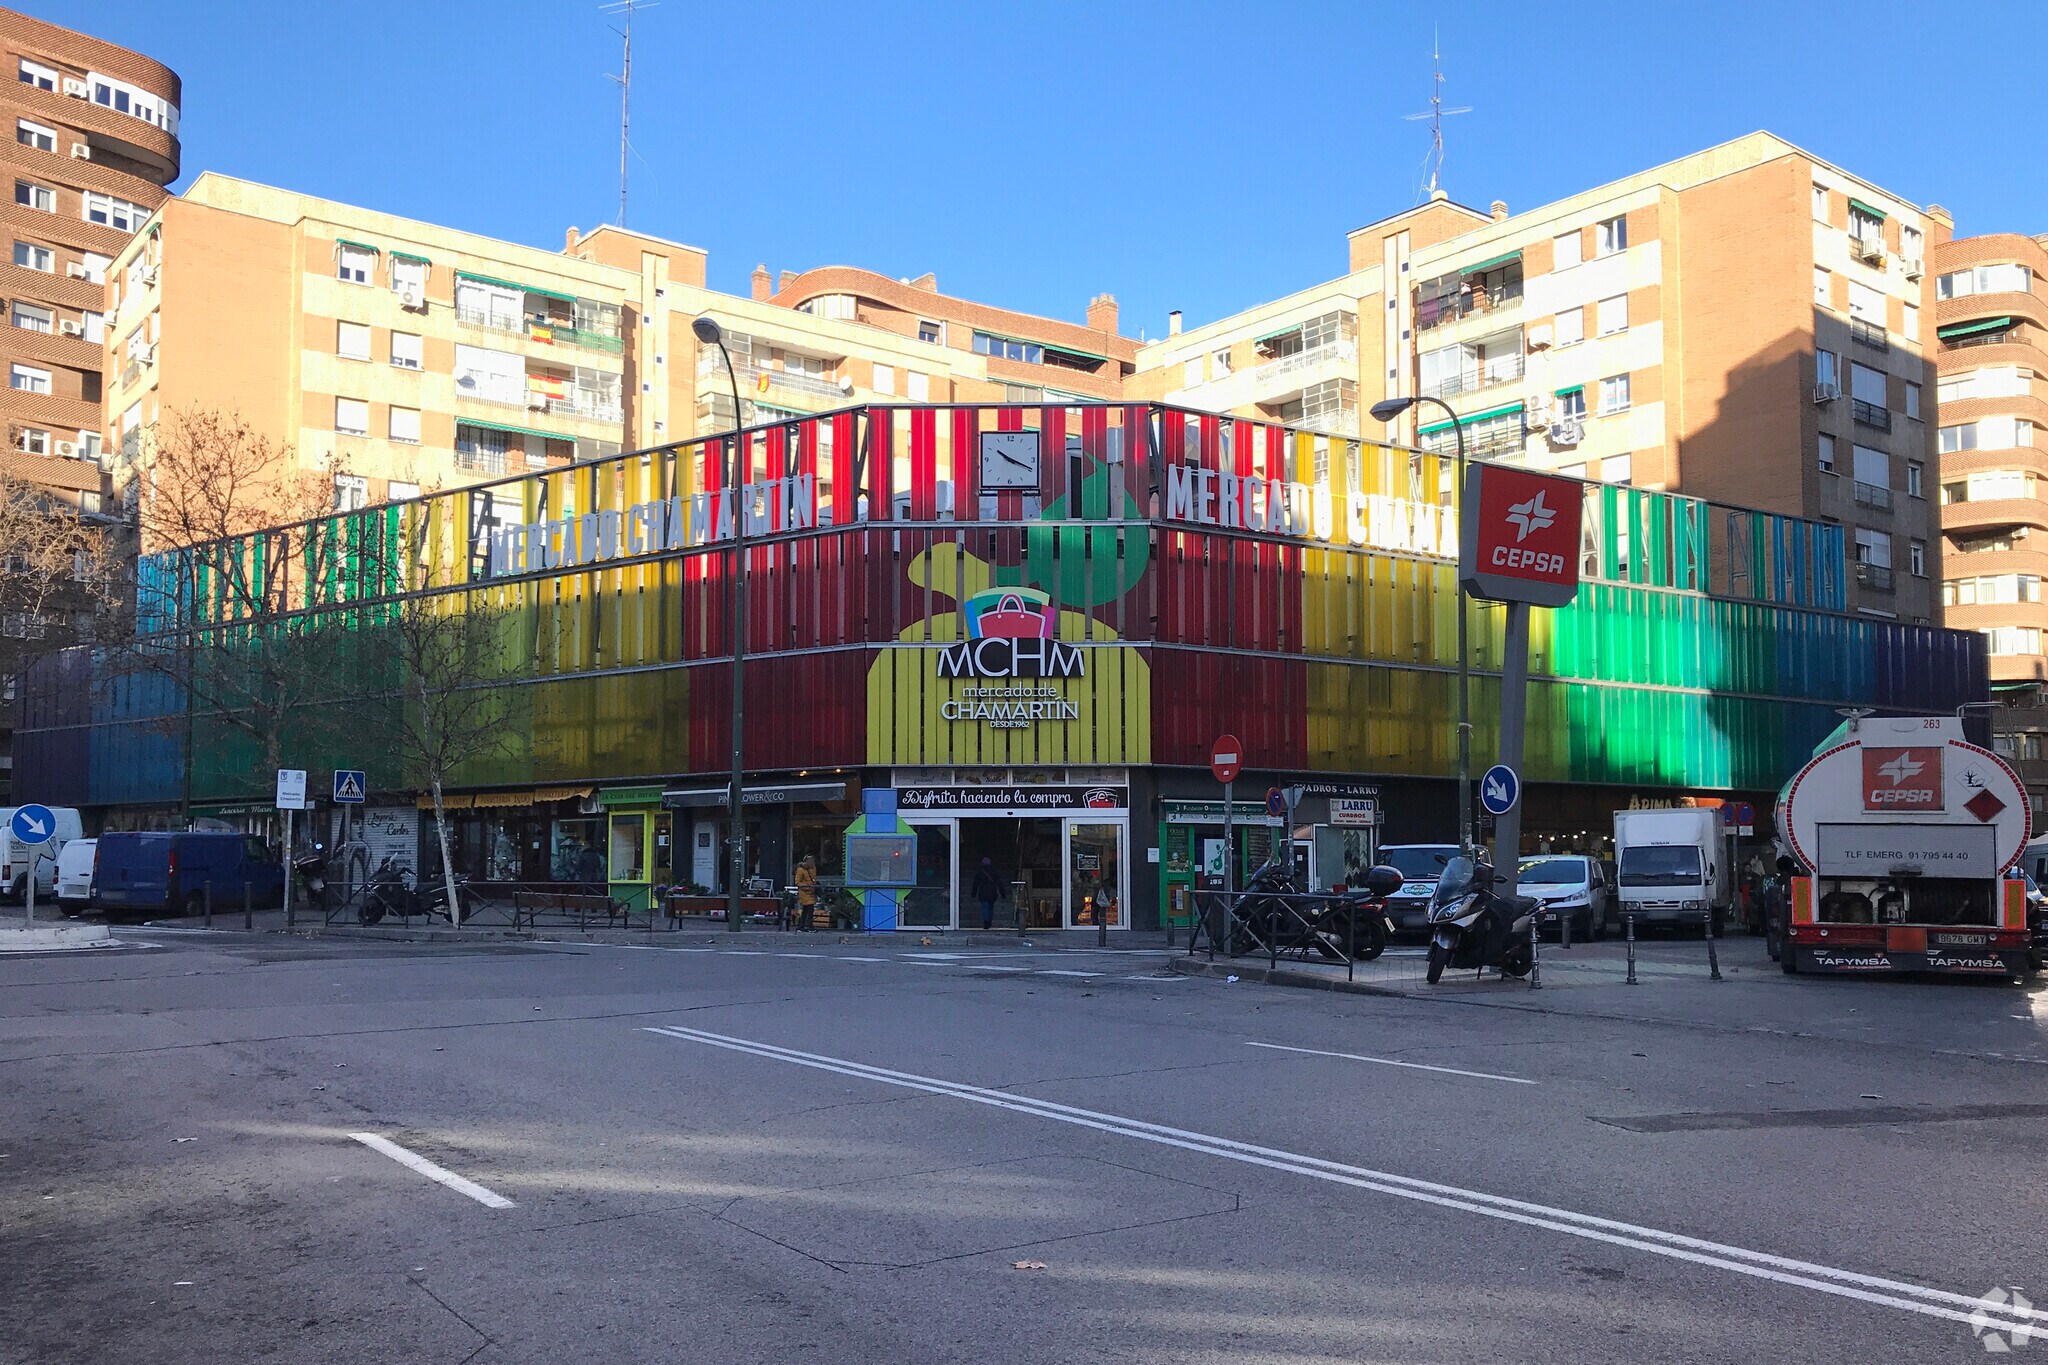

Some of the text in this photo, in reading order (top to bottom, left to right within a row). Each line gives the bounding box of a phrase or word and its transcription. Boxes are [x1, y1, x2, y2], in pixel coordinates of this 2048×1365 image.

[1167, 463, 1460, 558] MERCADO CHAMA
[491, 509, 617, 577] MERCADO
[1491, 545, 1565, 575] CEPSA
[937, 636, 1085, 677] MCHM
[962, 682, 1057, 698] mercado de
[941, 696, 1079, 720] CHAMARTÍN
[1923, 719, 1941, 729] 263
[902, 789, 1073, 808] Disfruta haciendo la compra
[1347, 786, 1378, 795] LARRU
[1870, 788, 1934, 804] CEPSA
[1341, 800, 1372, 811] LARRU
[1844, 850, 1969, 860] TLF EMERG 91 795 44 40
[1816, 957, 1891, 966] TAFYMSA
[1926, 957, 2006, 968] TAFYMSA
